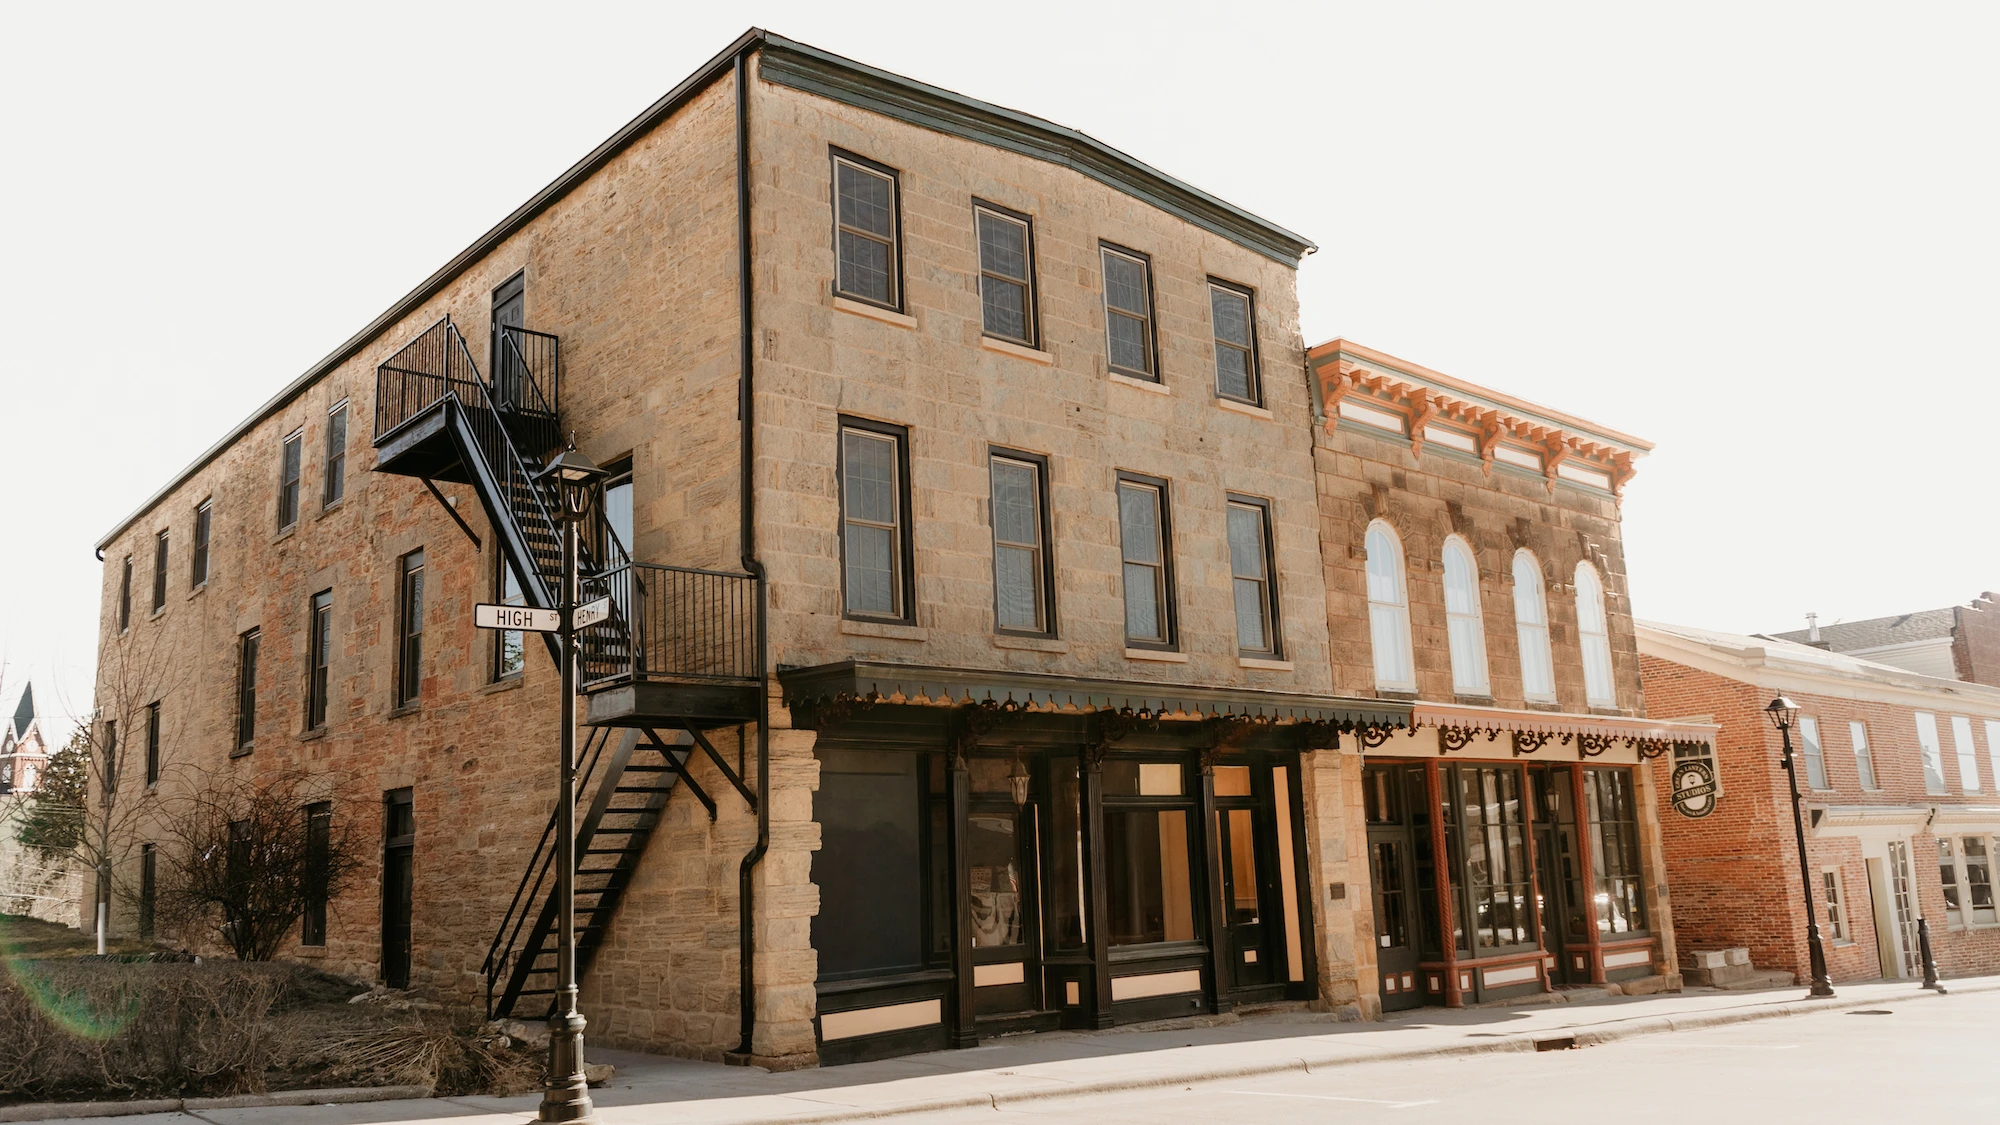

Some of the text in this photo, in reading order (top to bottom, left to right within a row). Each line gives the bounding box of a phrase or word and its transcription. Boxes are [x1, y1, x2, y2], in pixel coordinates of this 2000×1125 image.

[496, 609, 558, 627] HIGH ST
[577, 603, 600, 626] HENRY
[1676, 784, 1712, 801] STUDIOS
